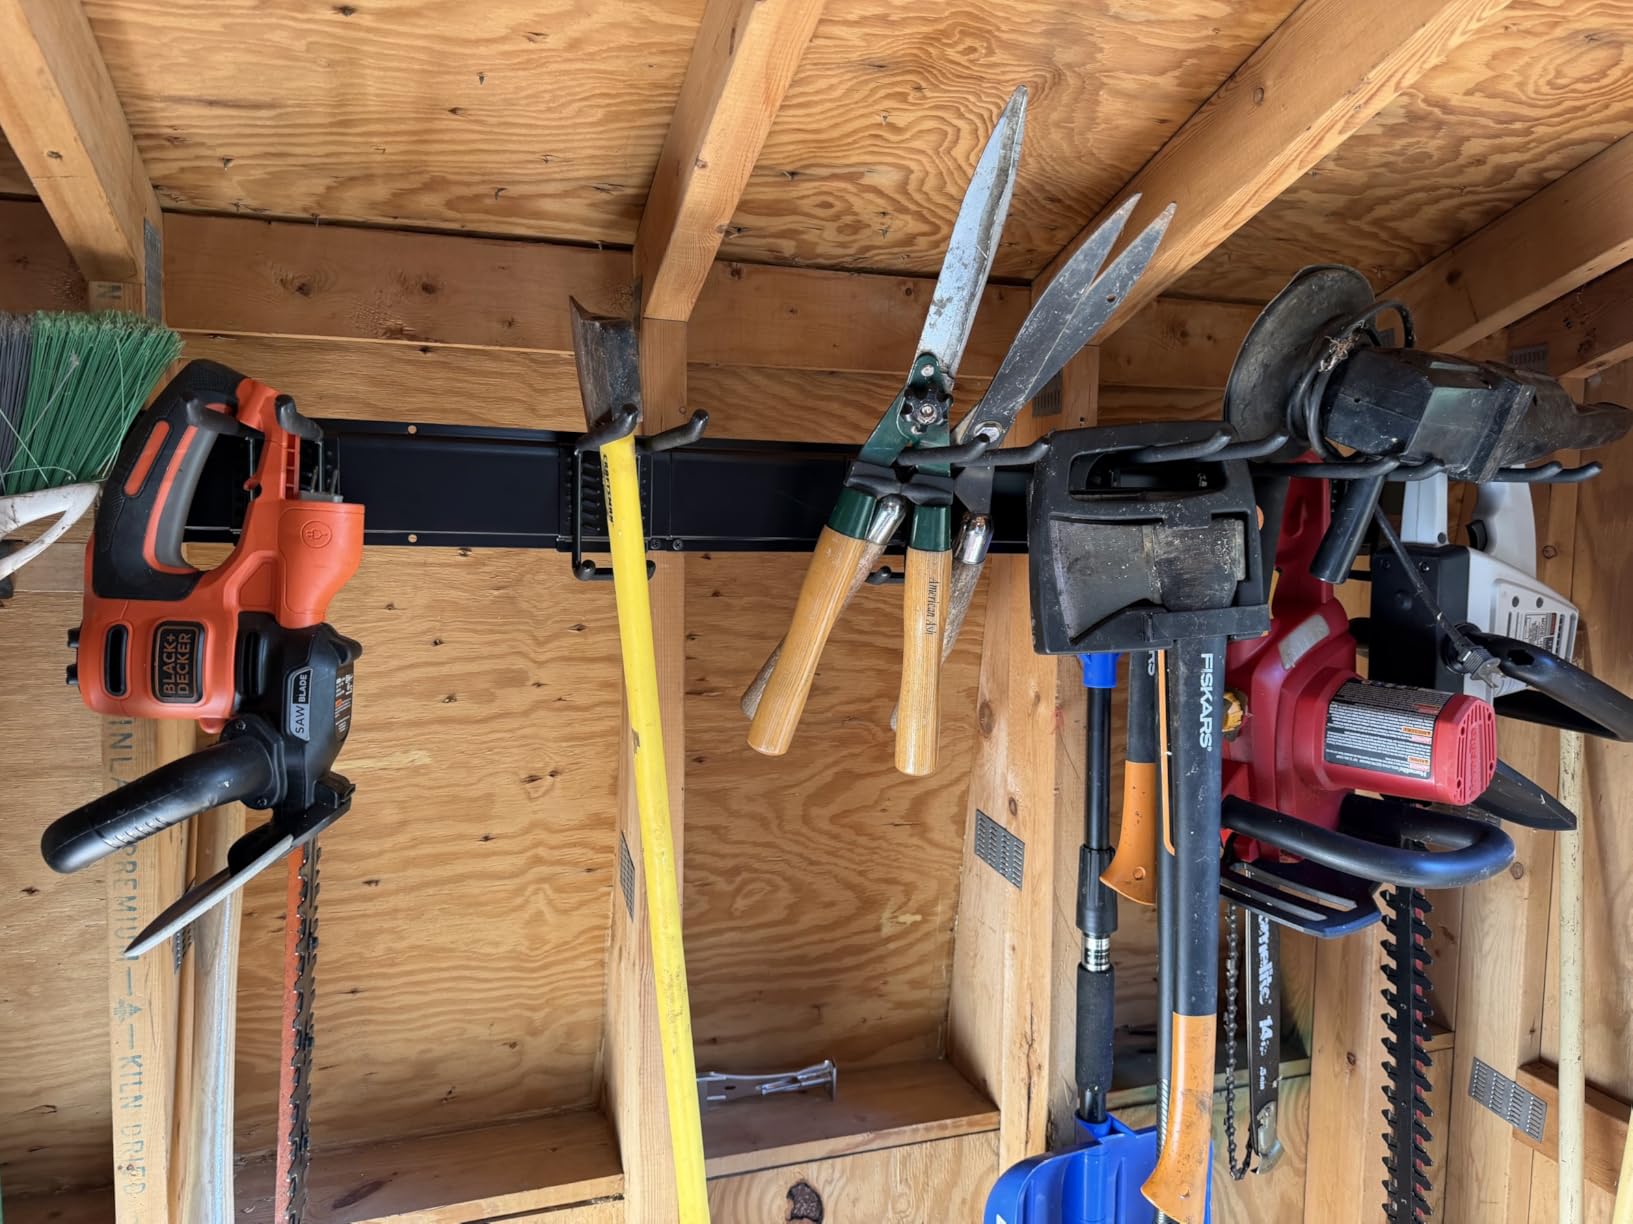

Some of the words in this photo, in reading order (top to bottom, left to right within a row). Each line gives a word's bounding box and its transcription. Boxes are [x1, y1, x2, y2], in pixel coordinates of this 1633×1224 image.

[927, 577, 941, 618] American
[163, 633, 177, 694] BLACK+
[177, 633, 192, 694] DECKER
[298, 674, 308, 703] BLADE
[295, 705, 305, 734] SAW
[1199, 653, 1214, 749] FISKARS
[1258, 914, 1273, 1005] omelite
[1259, 1015, 1273, 1040] 14
[118, 1054, 144, 1109] KILN
[120, 1124, 147, 1195] DRIED
